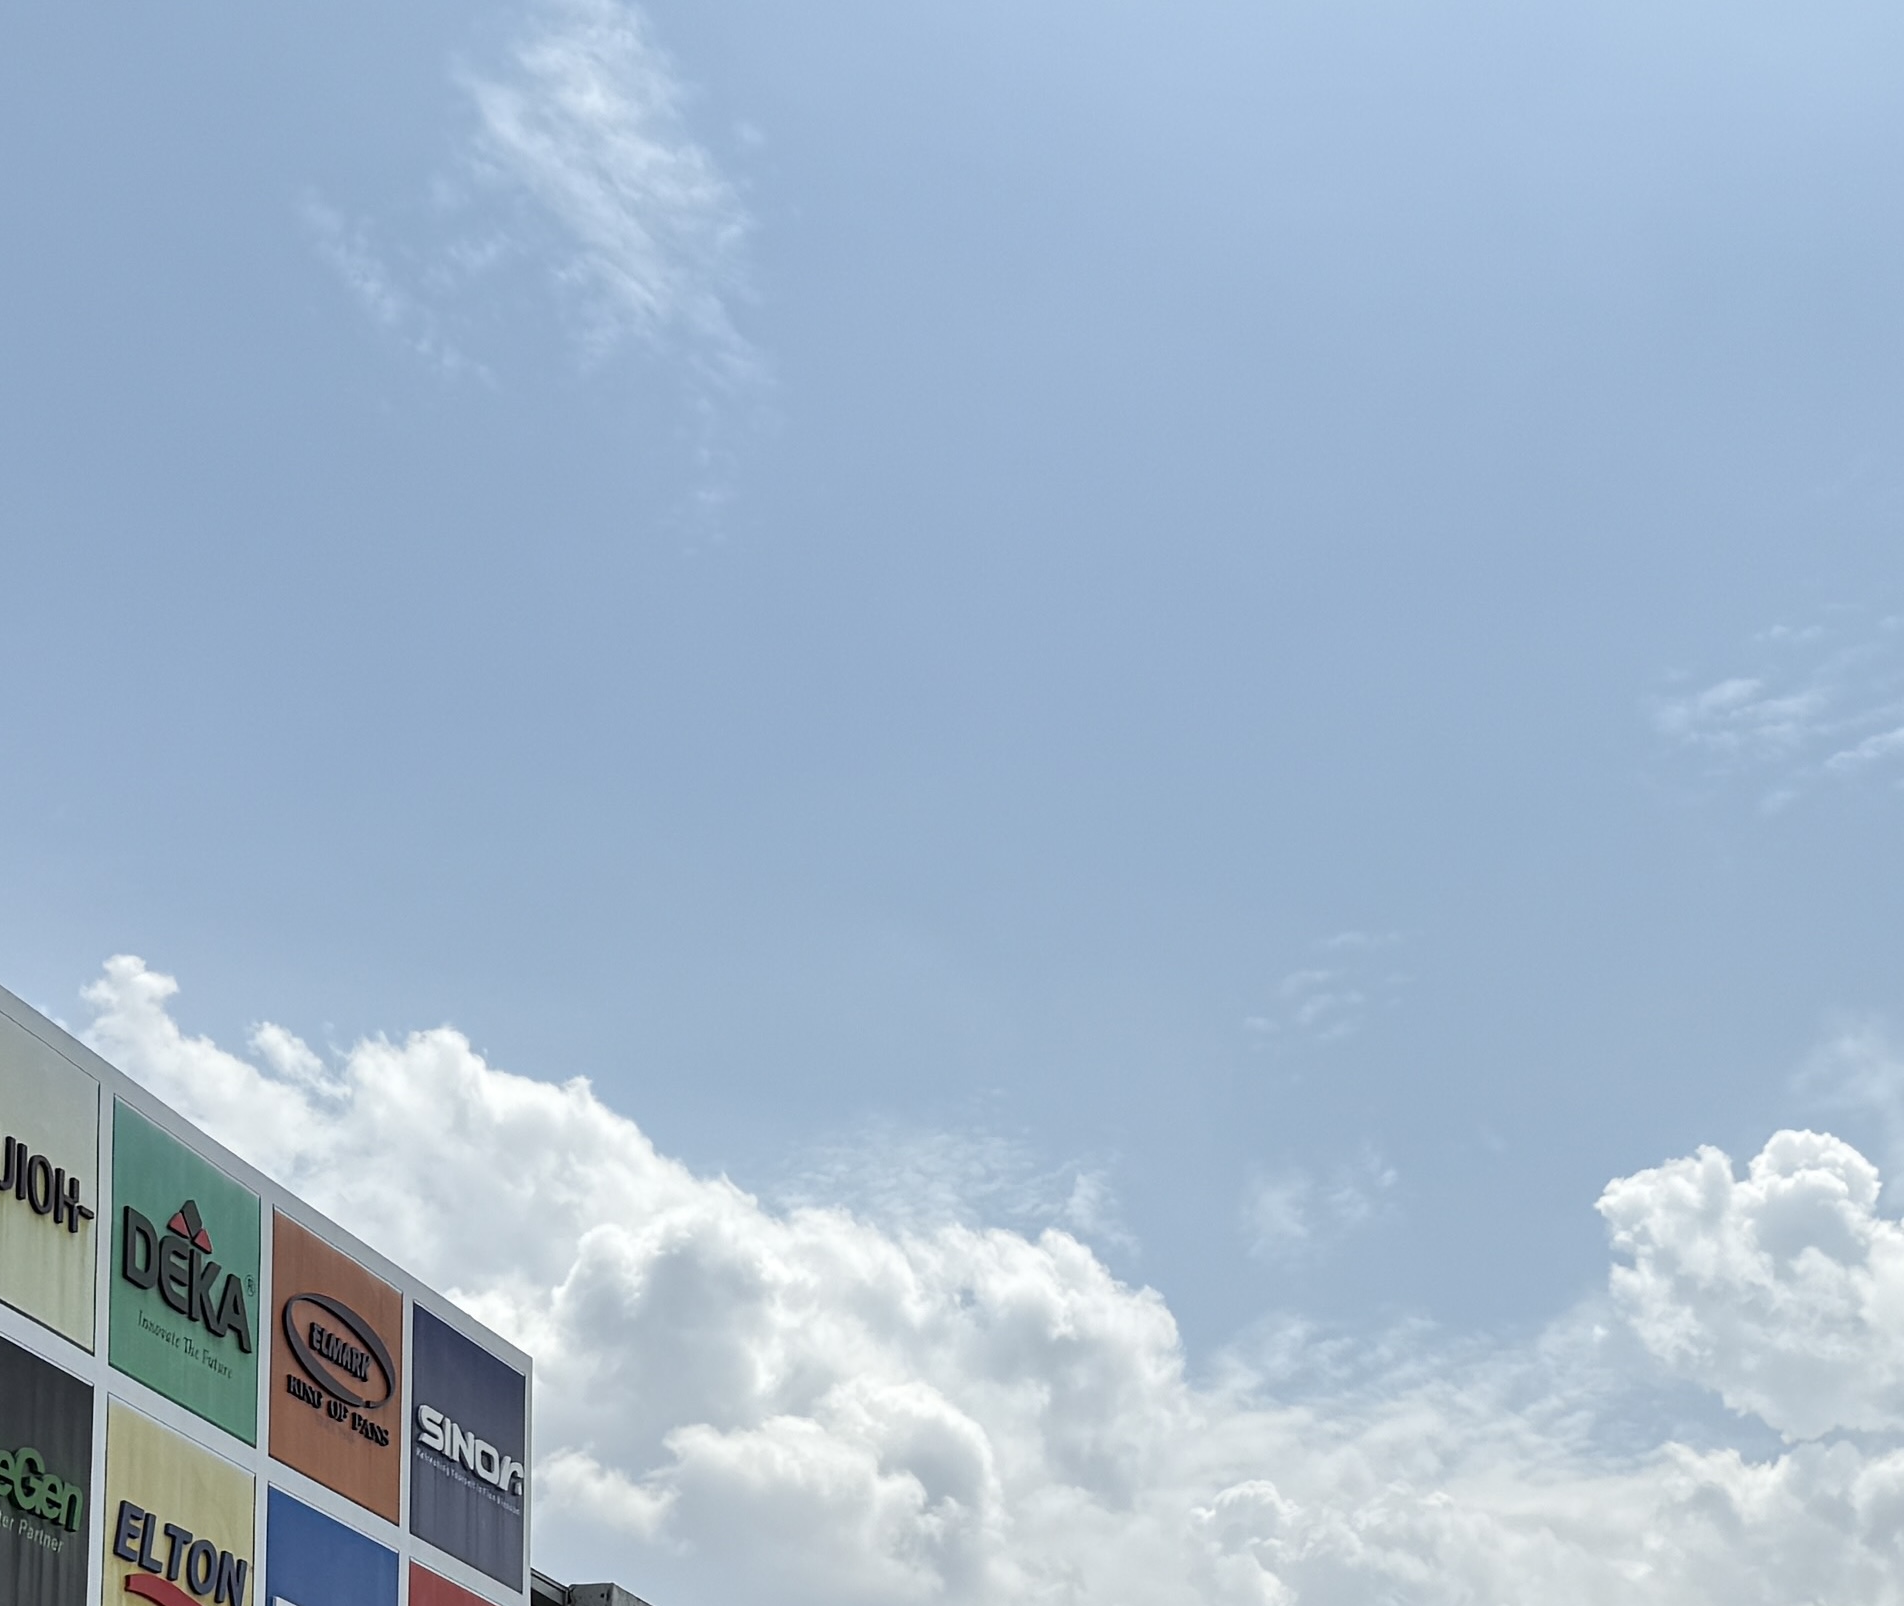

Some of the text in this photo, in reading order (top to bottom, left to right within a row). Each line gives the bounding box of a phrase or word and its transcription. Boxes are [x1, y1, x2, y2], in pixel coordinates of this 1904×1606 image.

[122, 1200, 253, 1354] DEKA
[309, 1322, 370, 1382] ELMARK
[287, 1374, 389, 1446] KING OF FANS
[18, 1519, 65, 1553] Partner
